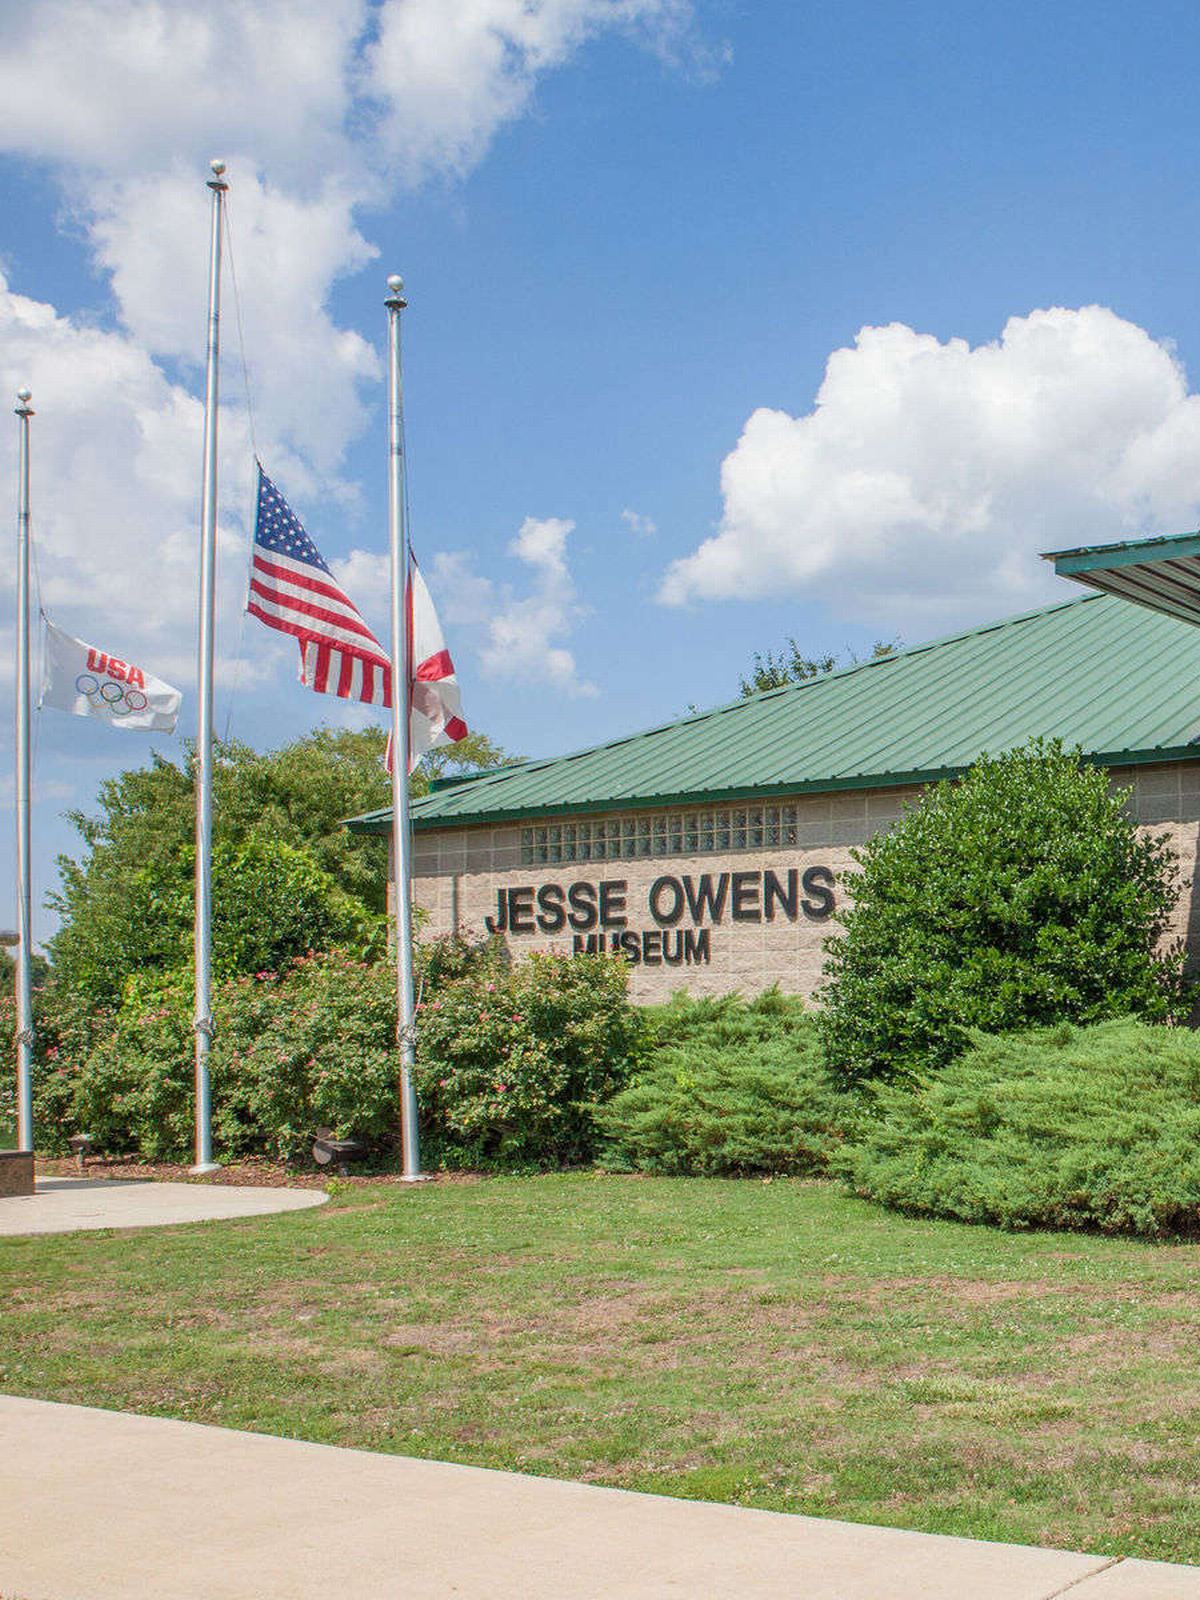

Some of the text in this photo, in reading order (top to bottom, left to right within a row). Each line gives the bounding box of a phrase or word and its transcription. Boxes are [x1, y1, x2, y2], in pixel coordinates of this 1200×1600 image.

[86, 649, 145, 689] USA
[485, 866, 836, 934] JESSE OWENS
